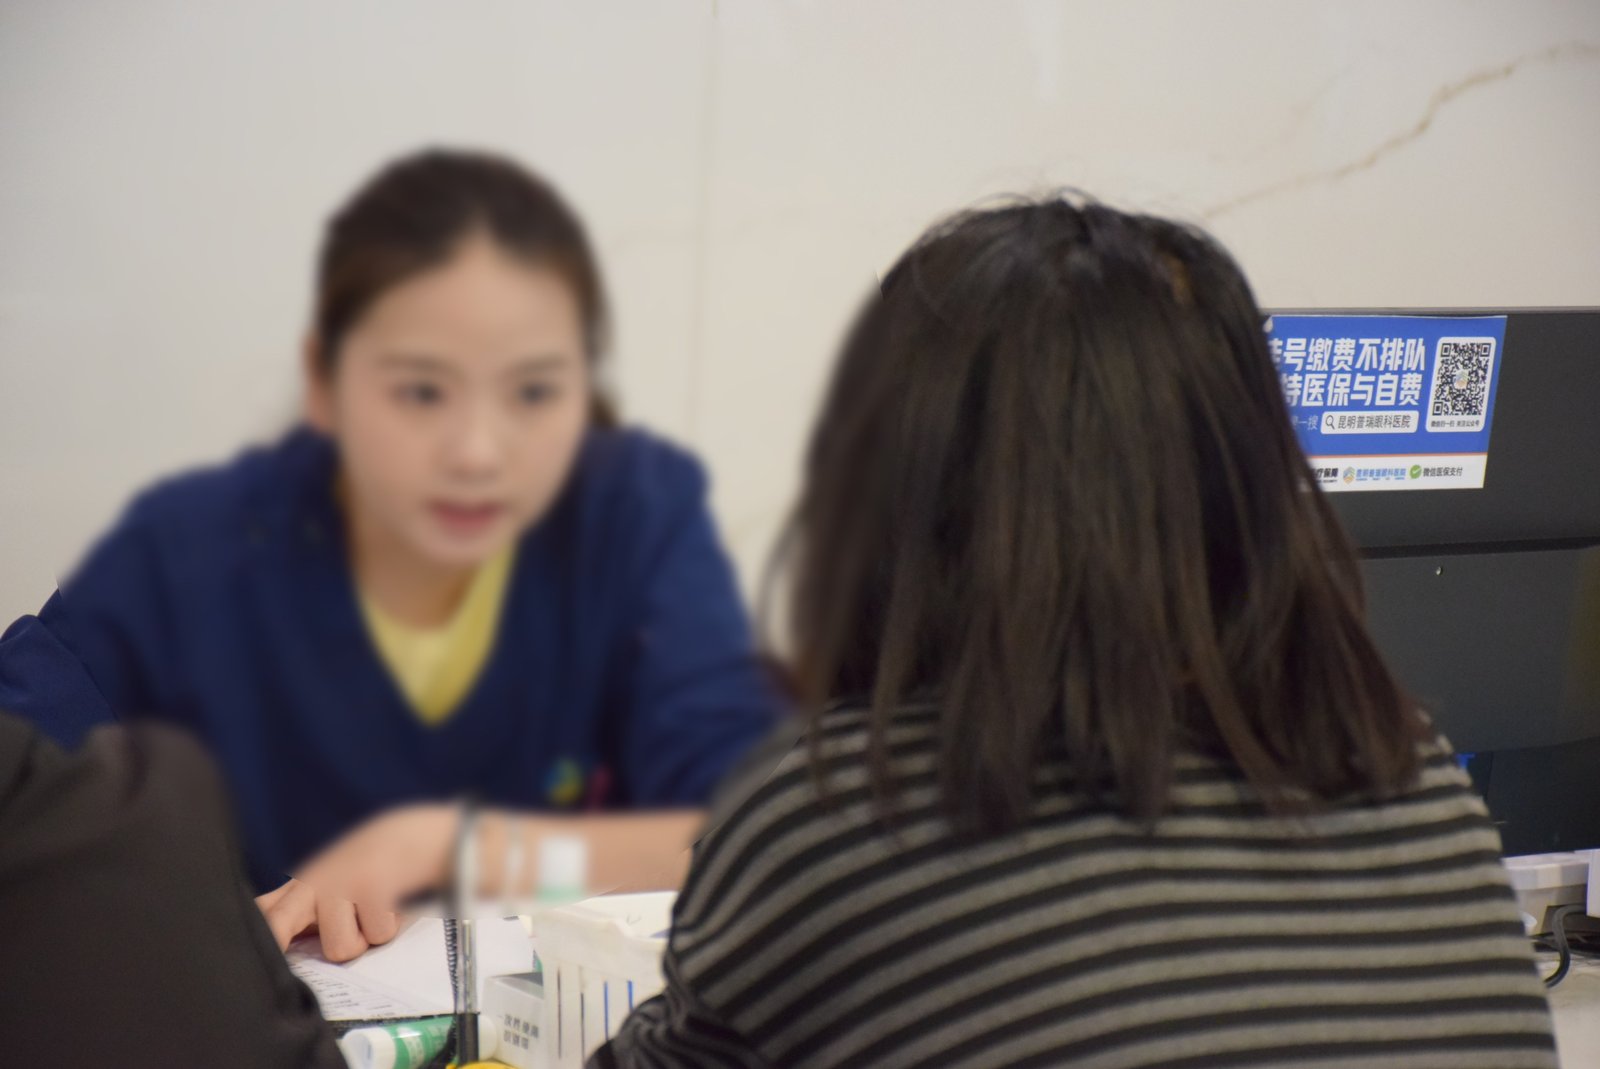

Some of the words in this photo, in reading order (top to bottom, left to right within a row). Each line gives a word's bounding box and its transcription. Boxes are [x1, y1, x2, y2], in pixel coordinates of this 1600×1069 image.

[1337, 415, 1411, 429] 昆明普瑞眼科医院
